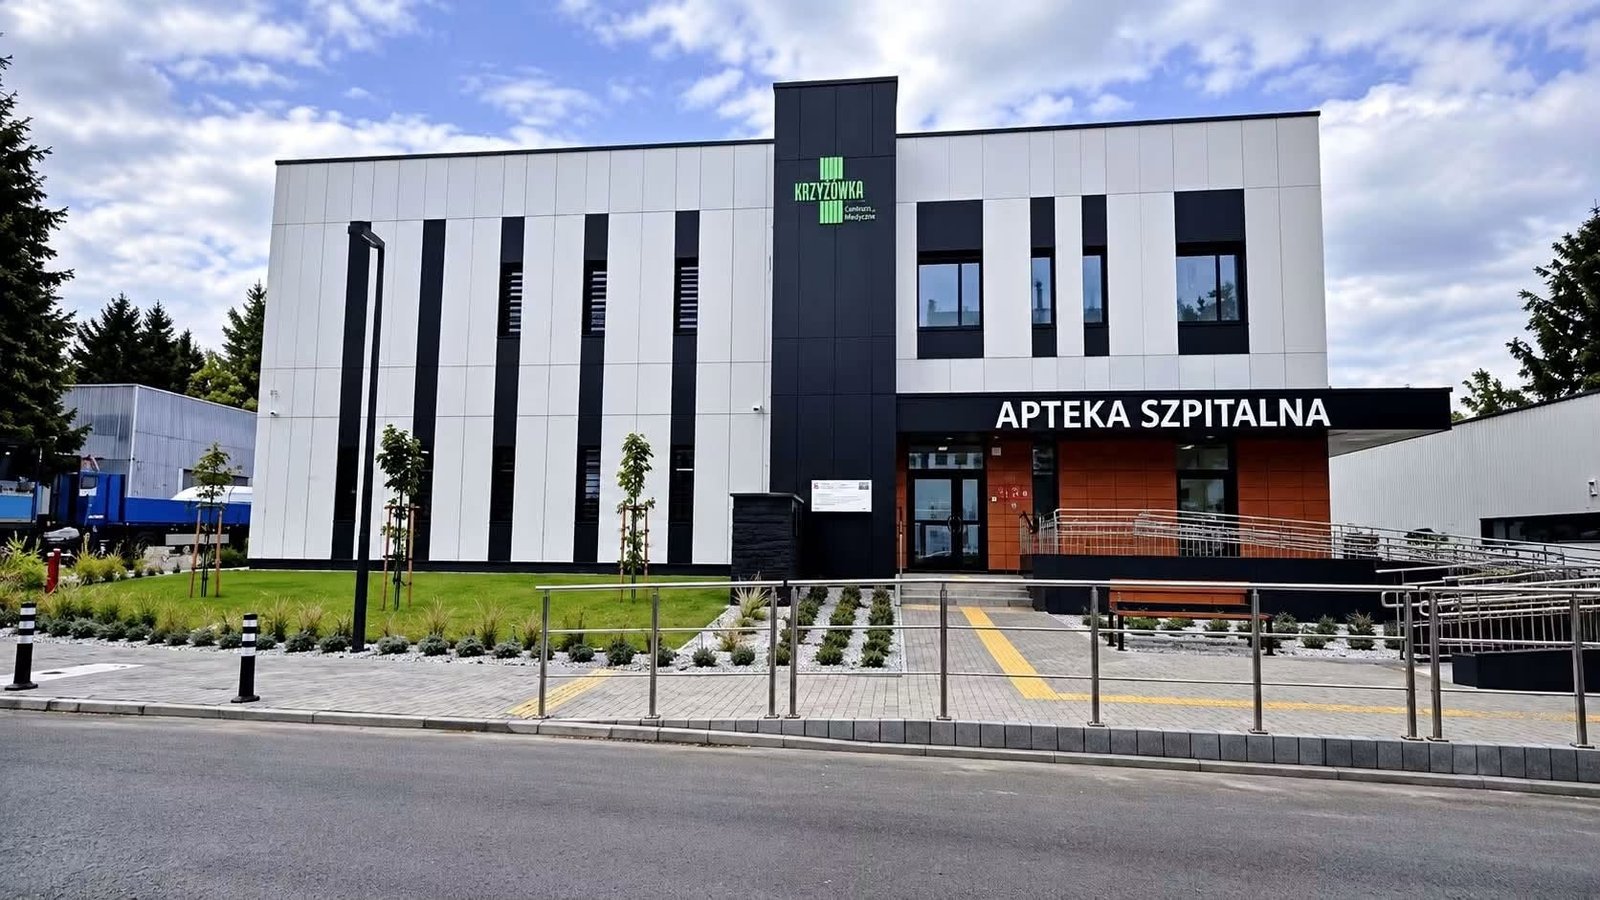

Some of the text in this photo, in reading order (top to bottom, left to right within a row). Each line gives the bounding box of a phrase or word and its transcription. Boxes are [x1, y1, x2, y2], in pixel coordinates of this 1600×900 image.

[795, 179, 864, 201] KRZYŻÓWKA
[844, 205, 872, 213] Centrum
[844, 213, 876, 222] Medyczne
[995, 398, 1331, 429] APTEKA SZPITALNA
